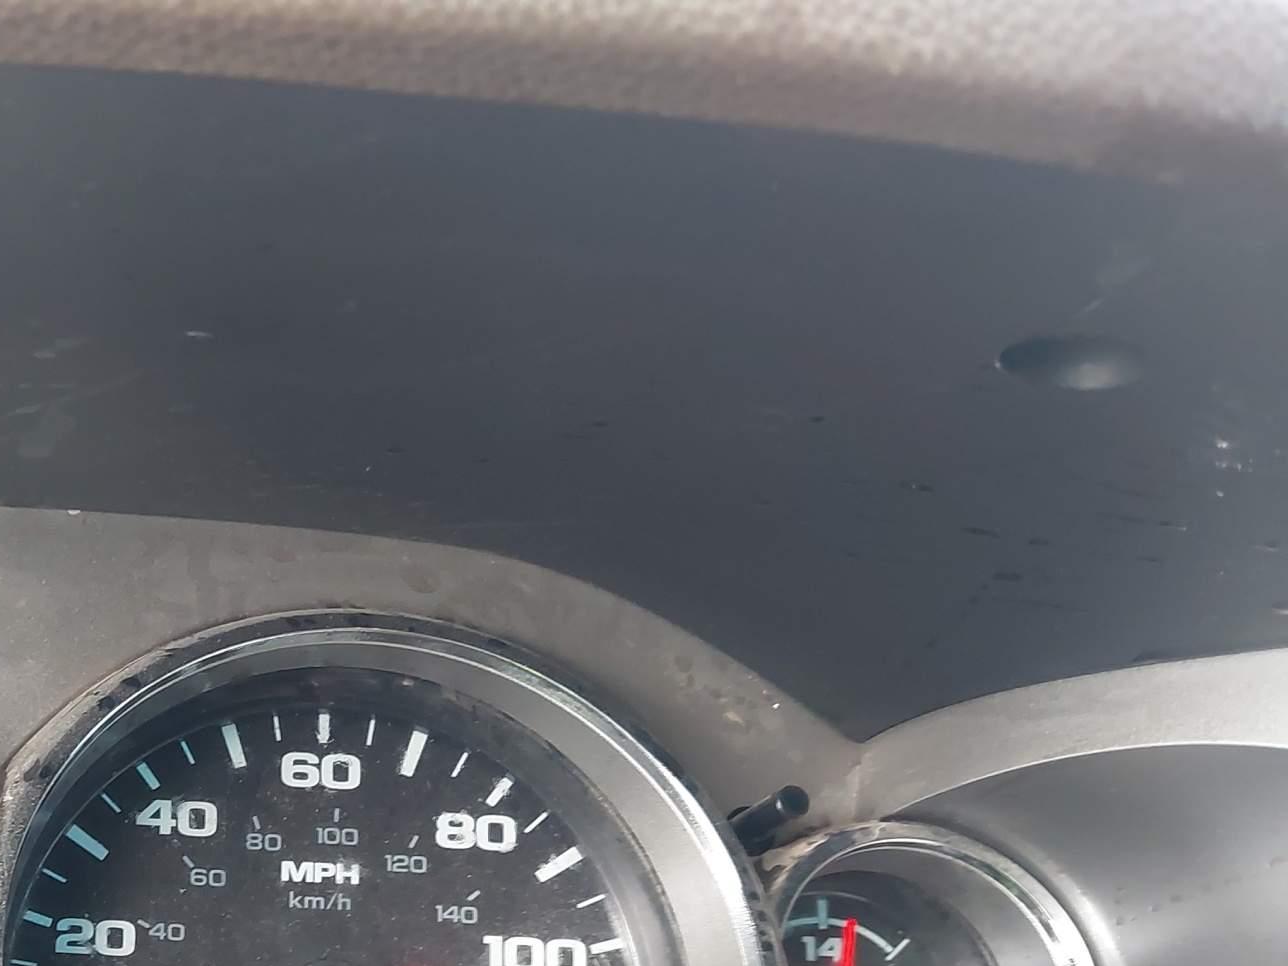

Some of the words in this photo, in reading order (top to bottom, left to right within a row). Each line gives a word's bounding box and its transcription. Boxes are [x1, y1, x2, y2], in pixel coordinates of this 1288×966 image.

[280, 752, 363, 791] 60
[135, 799, 218, 838] 40
[246, 831, 282, 852] 80
[316, 826, 359, 847] 100
[435, 814, 517, 853] 80
[280, 860, 360, 885] MPH
[385, 854, 428, 875] 120
[189, 867, 226, 888] 60
[288, 890, 351, 912] km/h
[436, 904, 478, 925] 140
[55, 919, 137, 958] 20
[148, 922, 185, 942] 40
[801, 936, 843, 962] 14
